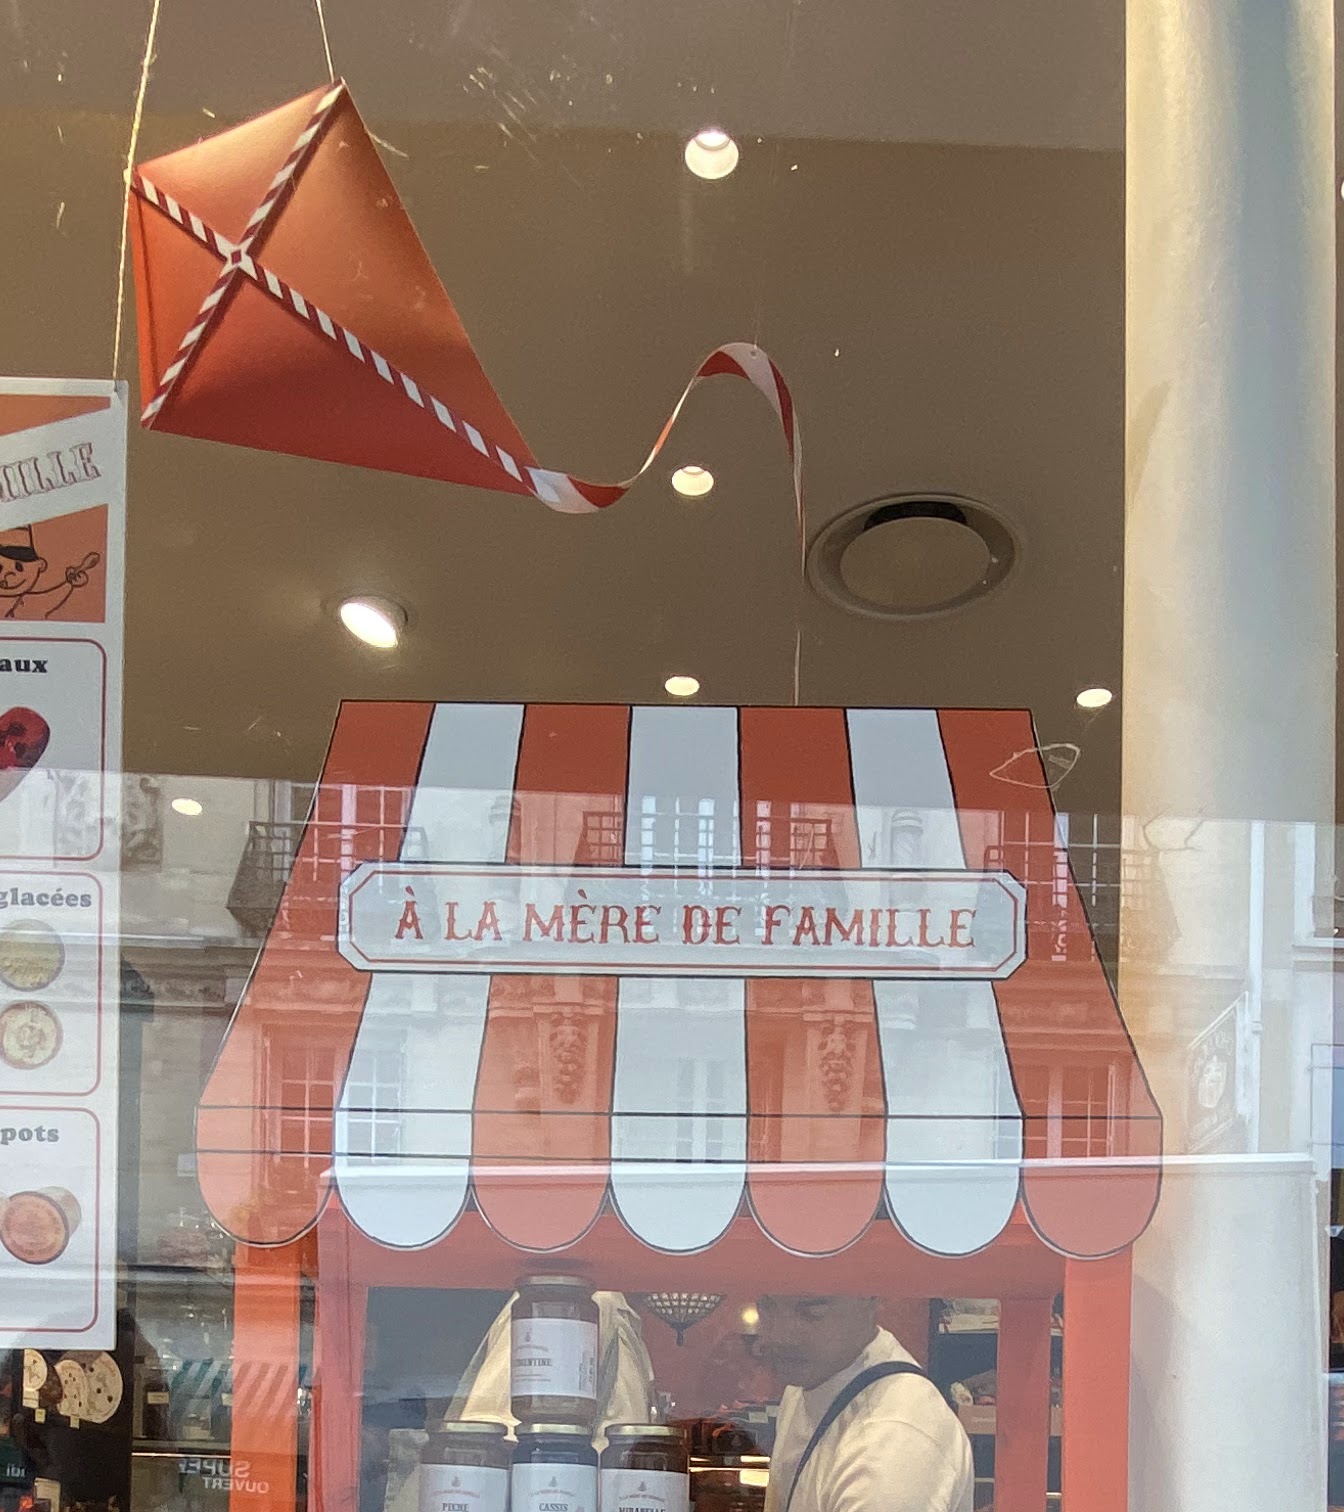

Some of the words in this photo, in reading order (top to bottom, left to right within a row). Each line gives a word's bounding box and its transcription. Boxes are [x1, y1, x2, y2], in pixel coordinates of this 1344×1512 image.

[394, 885, 425, 941] À
[444, 900, 503, 942] LA
[521, 888, 661, 946] MÈRE
[682, 904, 742, 946] DE
[761, 904, 978, 948] FAMILLE
[0, 1124, 60, 1146] pots
[538, 1502, 569, 1512] CASSIS
